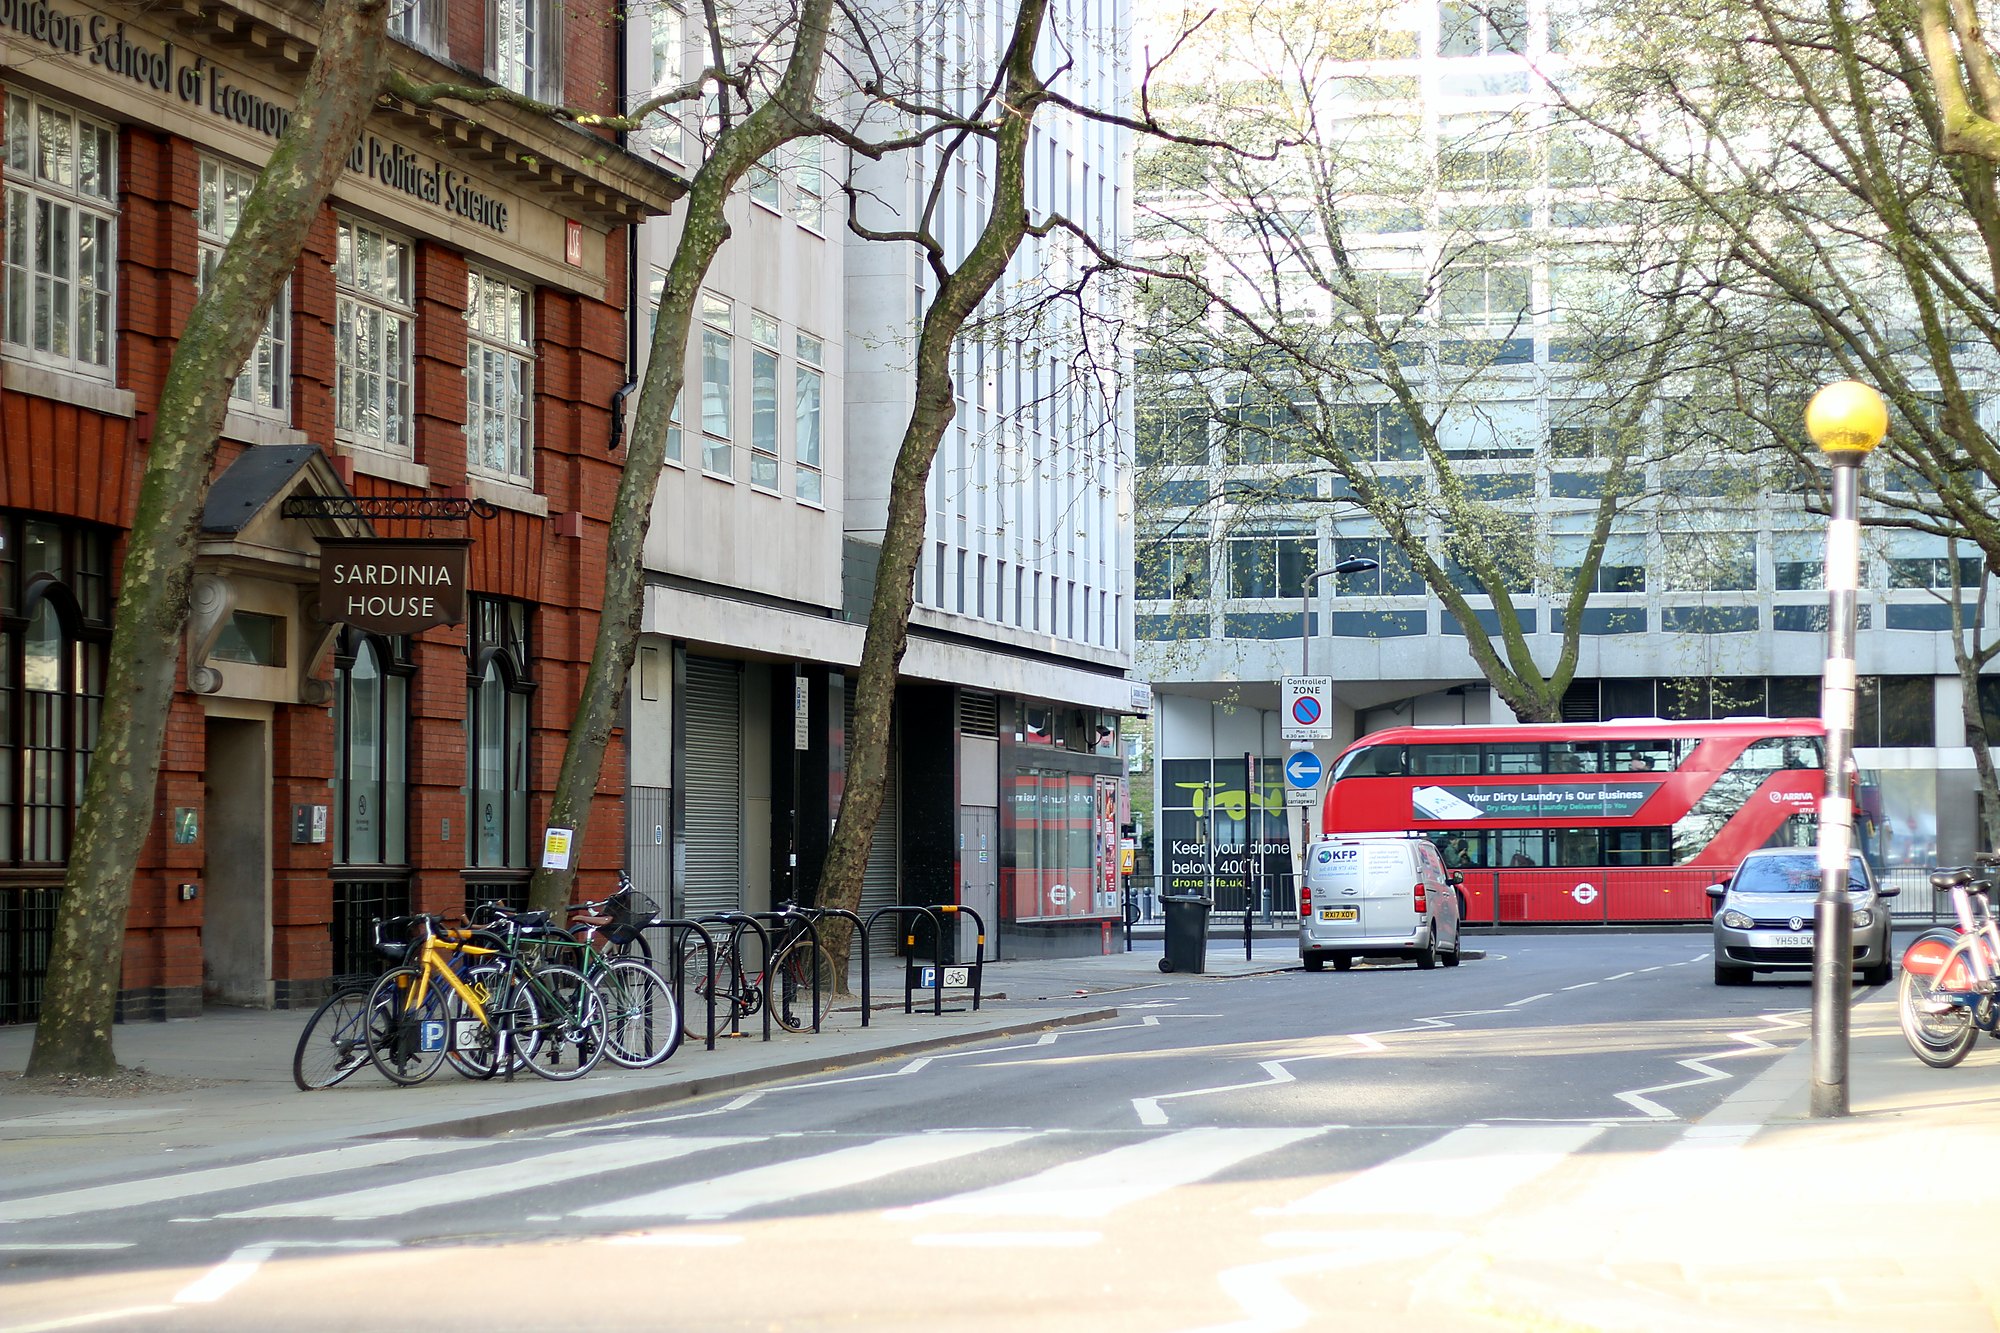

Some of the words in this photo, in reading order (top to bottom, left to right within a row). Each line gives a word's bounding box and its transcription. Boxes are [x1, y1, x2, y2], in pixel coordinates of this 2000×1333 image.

[0, 0, 83, 57] ondon
[90, 15, 174, 93] School
[178, 56, 207, 105] of
[210, 66, 293, 139] Econo
[369, 136, 441, 206] Political
[445, 170, 509, 233] Science
[570, 227, 580, 258] LSE
[333, 564, 452, 586] SARDINIA
[347, 596, 434, 617] HOUSE
[1467, 793, 1490, 802] Your
[1493, 792, 1518, 803] Dirty
[1521, 792, 1562, 802] Laundry
[1565, 791, 1574, 800] is
[1576, 791, 1596, 800] Our
[1598, 790, 1643, 800] Business
[1782, 792, 1814, 800] ARRIVA
[1501, 804, 1531, 812] Cleaning
[1540, 803, 1568, 811] Laundry
[1172, 840, 1206, 857] Keep
[1214, 843, 1245, 857] your
[1250, 841, 1290, 854] drone
[1333, 850, 1357, 859] KFP
[1172, 860, 1216, 874] below
[1220, 860, 1260, 874] 400t
[1775, 937, 1798, 945] YH59
[1801, 937, 1813, 945] CK
[925, 969, 935, 986] P
[426, 1023, 444, 1049] P
